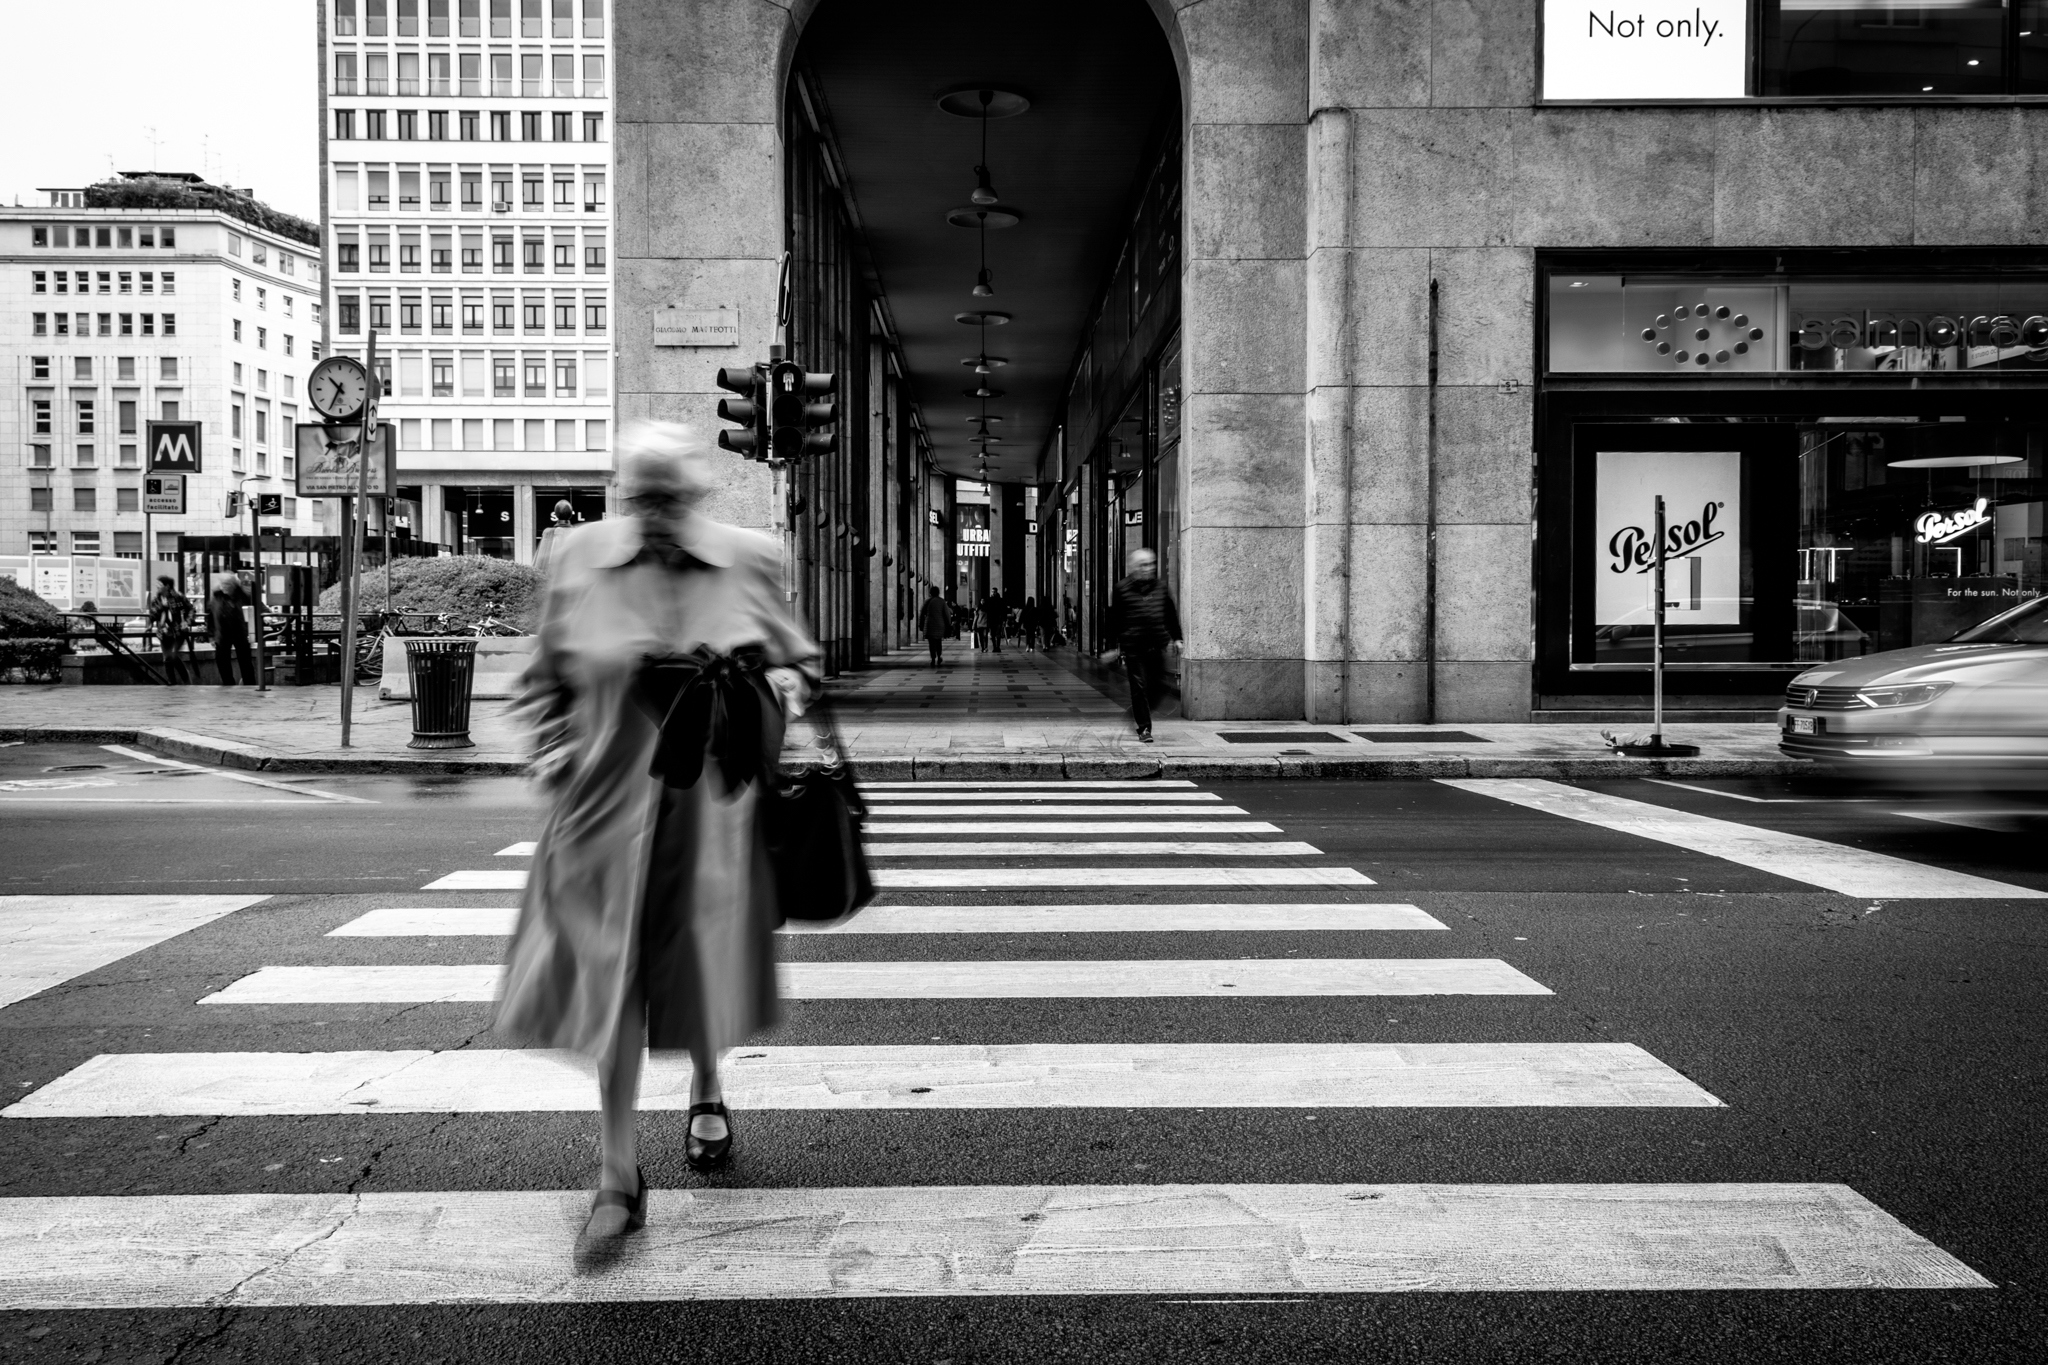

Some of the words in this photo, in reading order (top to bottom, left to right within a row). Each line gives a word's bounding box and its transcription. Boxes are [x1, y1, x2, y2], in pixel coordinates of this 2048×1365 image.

[1589, 10, 1645, 38] Not
[1656, 7, 1724, 47] only.
[154, 433, 194, 462] M
[1609, 502, 1725, 574] Pesol
[1947, 588, 1962, 596] For
[1964, 587, 1978, 596] the
[2002, 588, 2019, 597] Not
